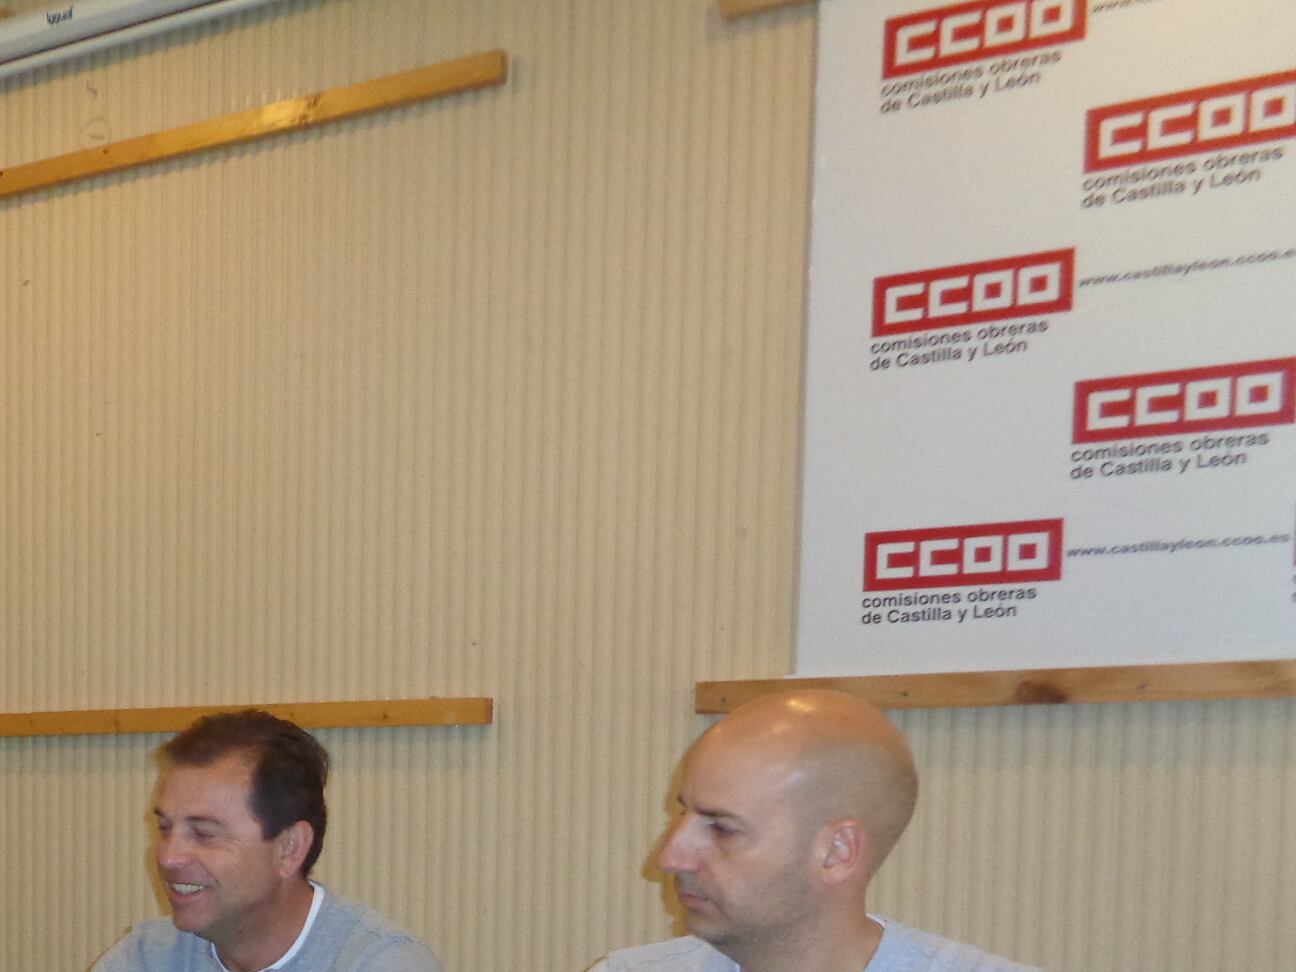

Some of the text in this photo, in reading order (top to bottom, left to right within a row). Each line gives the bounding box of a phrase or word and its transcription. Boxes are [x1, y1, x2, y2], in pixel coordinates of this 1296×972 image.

[892, 0, 1076, 67] CCOO
[880, 71, 1041, 114] de Castilla y León
[881, 51, 1062, 96] comisiones obreras
[1097, 84, 1296, 160] CCOO
[1081, 167, 1262, 208] de Castilla y León
[1082, 146, 1284, 191] comisiones obreras
[883, 261, 1063, 325] CCOO
[870, 337, 1028, 371] de Castilla y León
[871, 320, 1049, 354] comisiones obreras
[1085, 370, 1286, 432] CCOO
[1070, 431, 1270, 462] comisiones obreras
[1070, 449, 1247, 479] de Castilla y León
[875, 530, 1050, 580] CCOO
[861, 602, 1017, 624] de Castilla y León
[862, 586, 1038, 609] comisiones obreras
